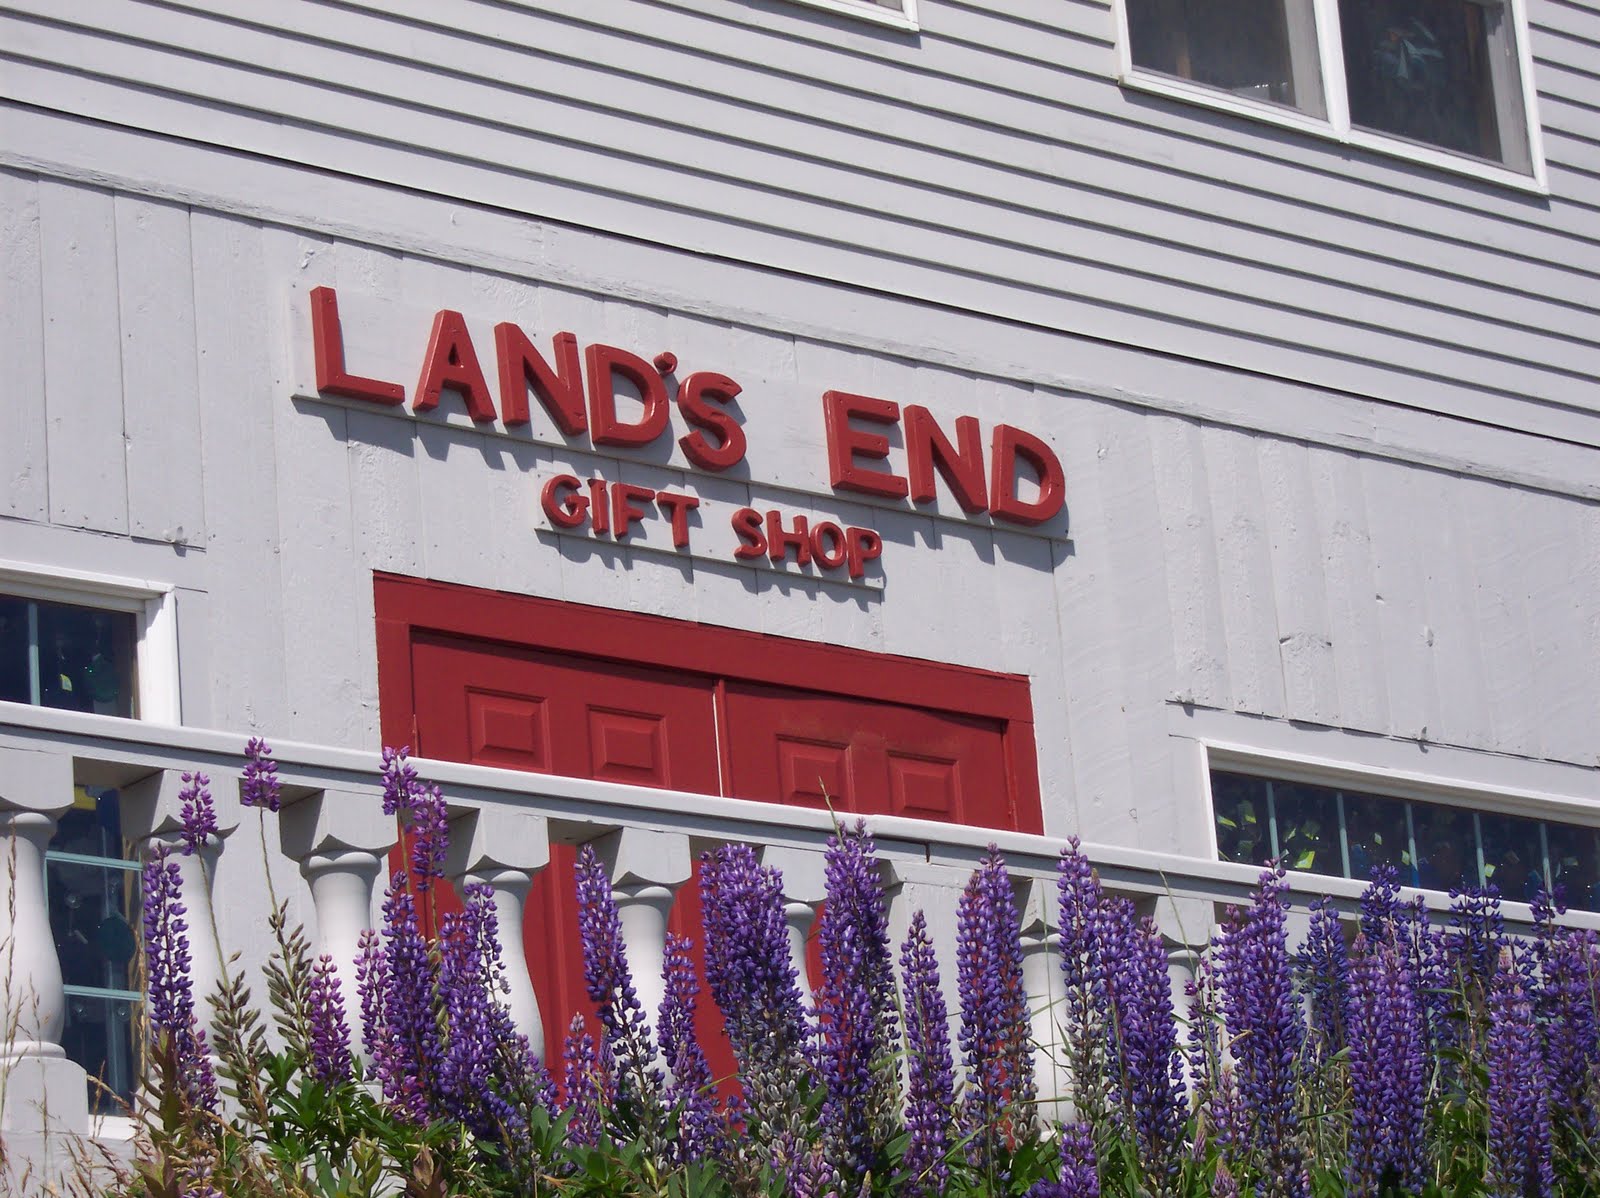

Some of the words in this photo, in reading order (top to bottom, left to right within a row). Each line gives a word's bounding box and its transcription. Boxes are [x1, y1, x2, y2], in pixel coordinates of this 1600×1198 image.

[310, 286, 747, 472] LAND'S
[823, 390, 1066, 527] END
[541, 474, 700, 548] GIFT
[732, 508, 882, 579] SHOP
